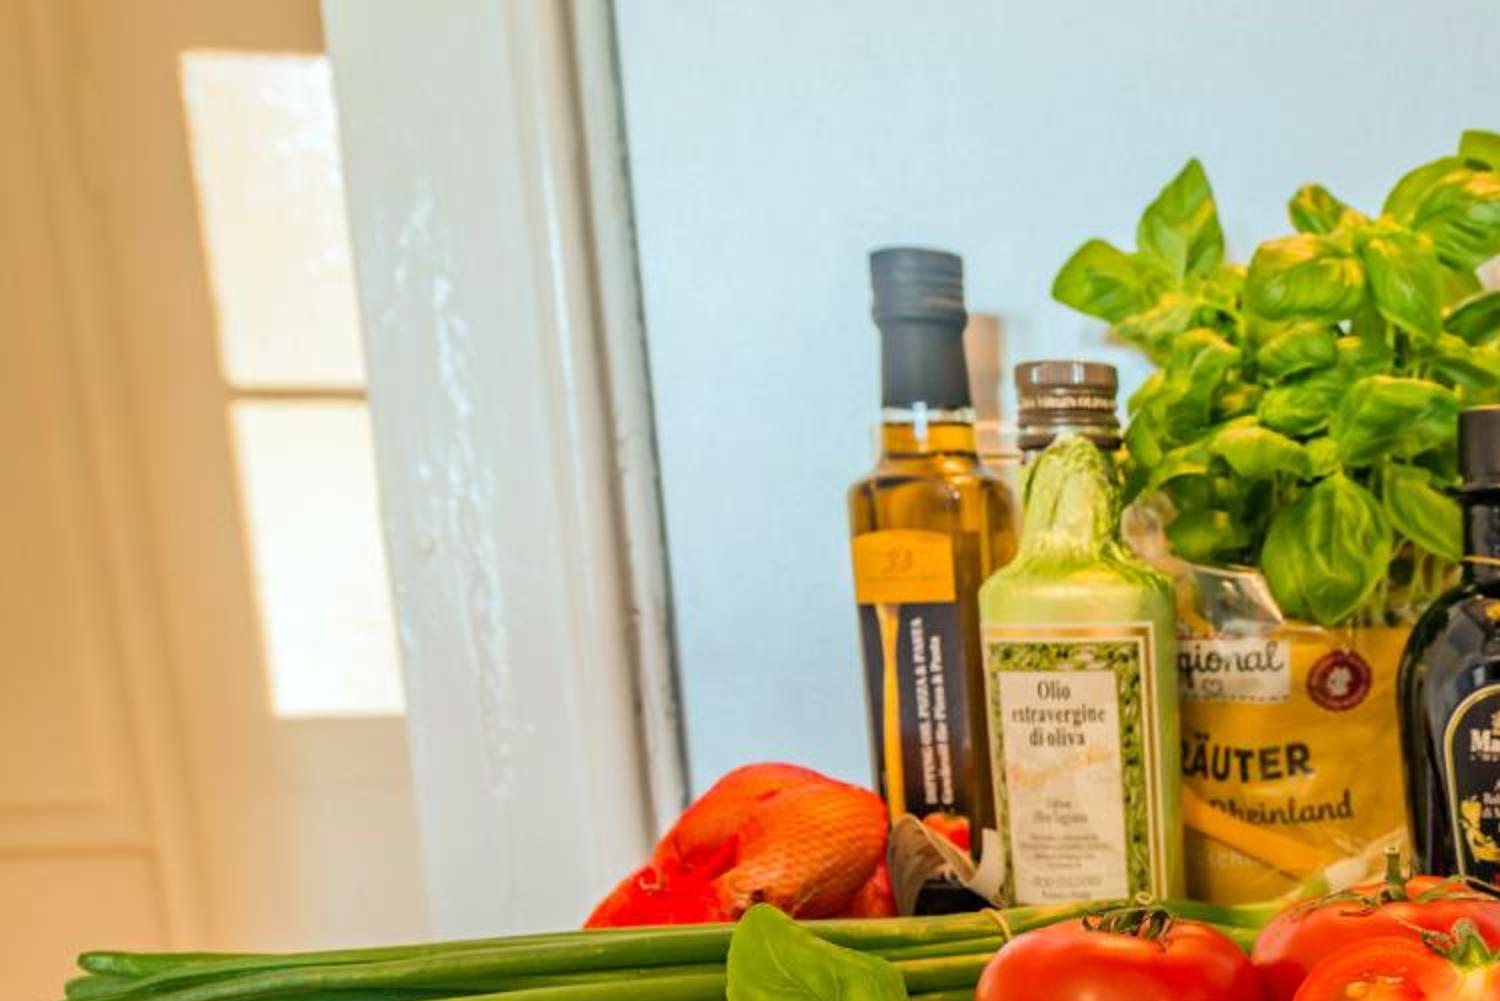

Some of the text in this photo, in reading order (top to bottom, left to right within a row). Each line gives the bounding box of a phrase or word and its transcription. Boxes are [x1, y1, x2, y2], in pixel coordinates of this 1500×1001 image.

[1178, 640, 1284, 690] gional
[1036, 680, 1072, 700] Olio
[1029, 727, 1086, 747] di oliva
